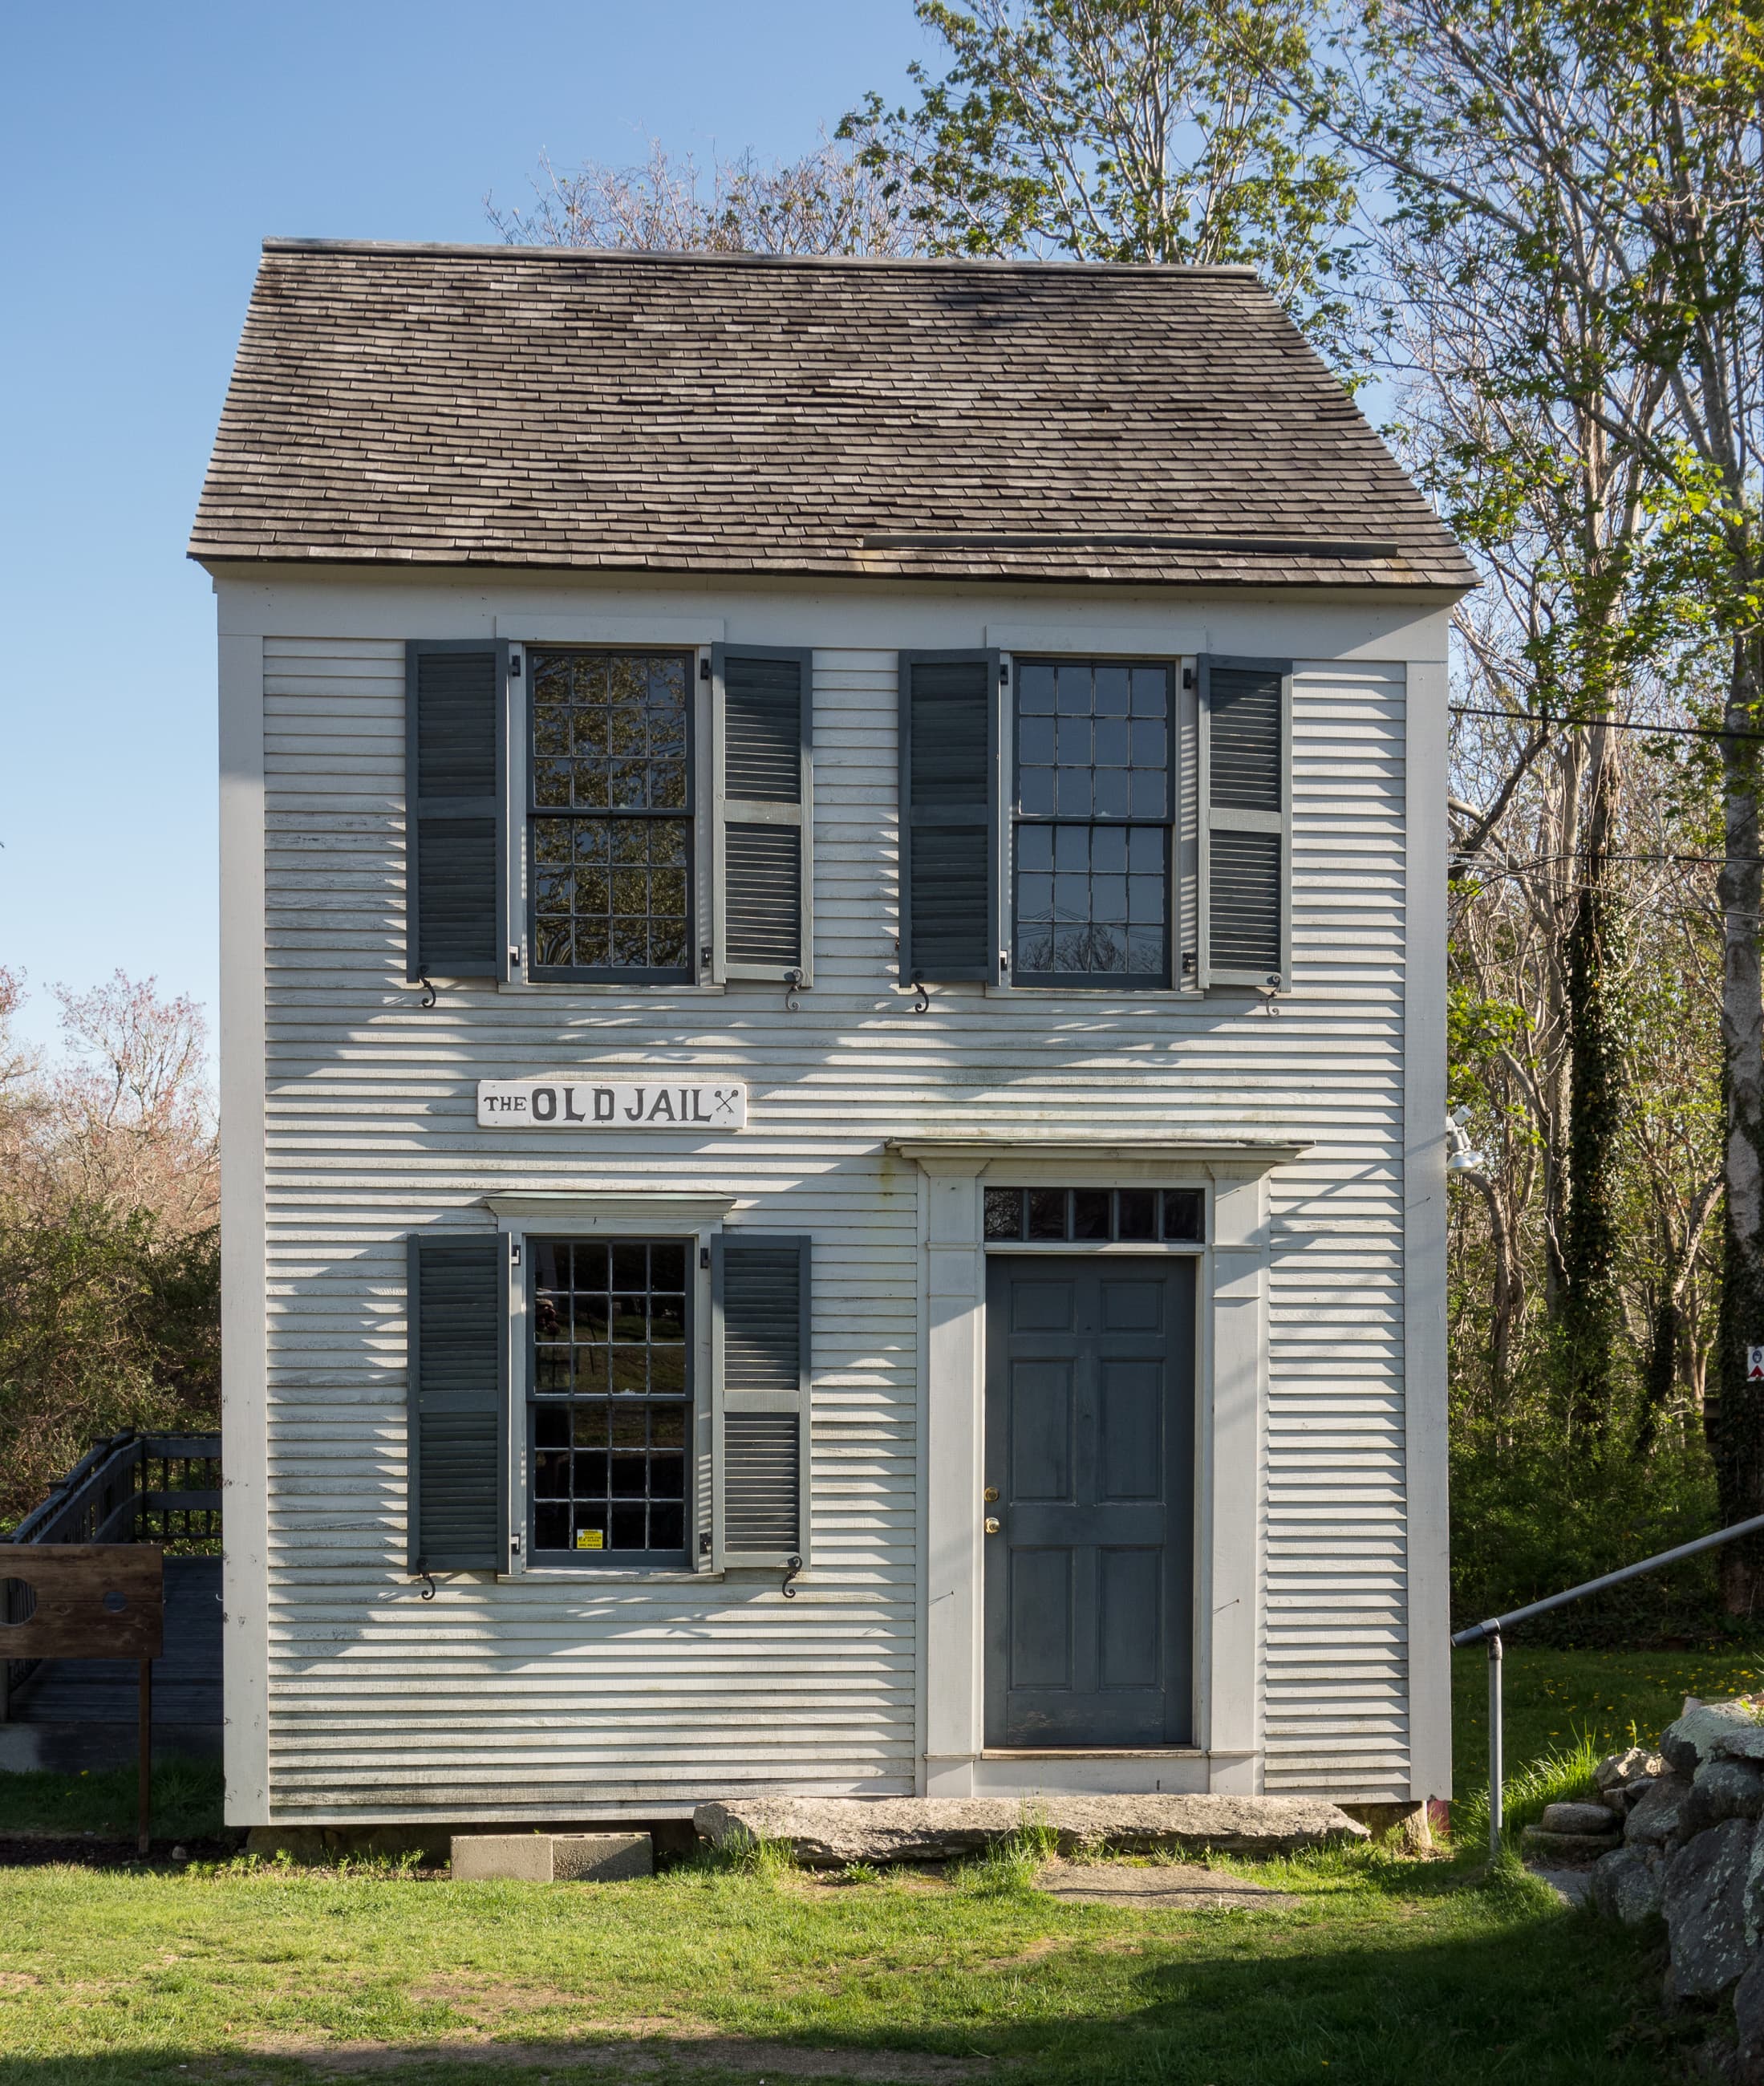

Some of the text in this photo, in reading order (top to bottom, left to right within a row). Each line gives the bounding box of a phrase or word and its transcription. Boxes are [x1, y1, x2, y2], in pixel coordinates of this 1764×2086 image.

[484, 1088, 712, 1122] THE OLD JAIL
